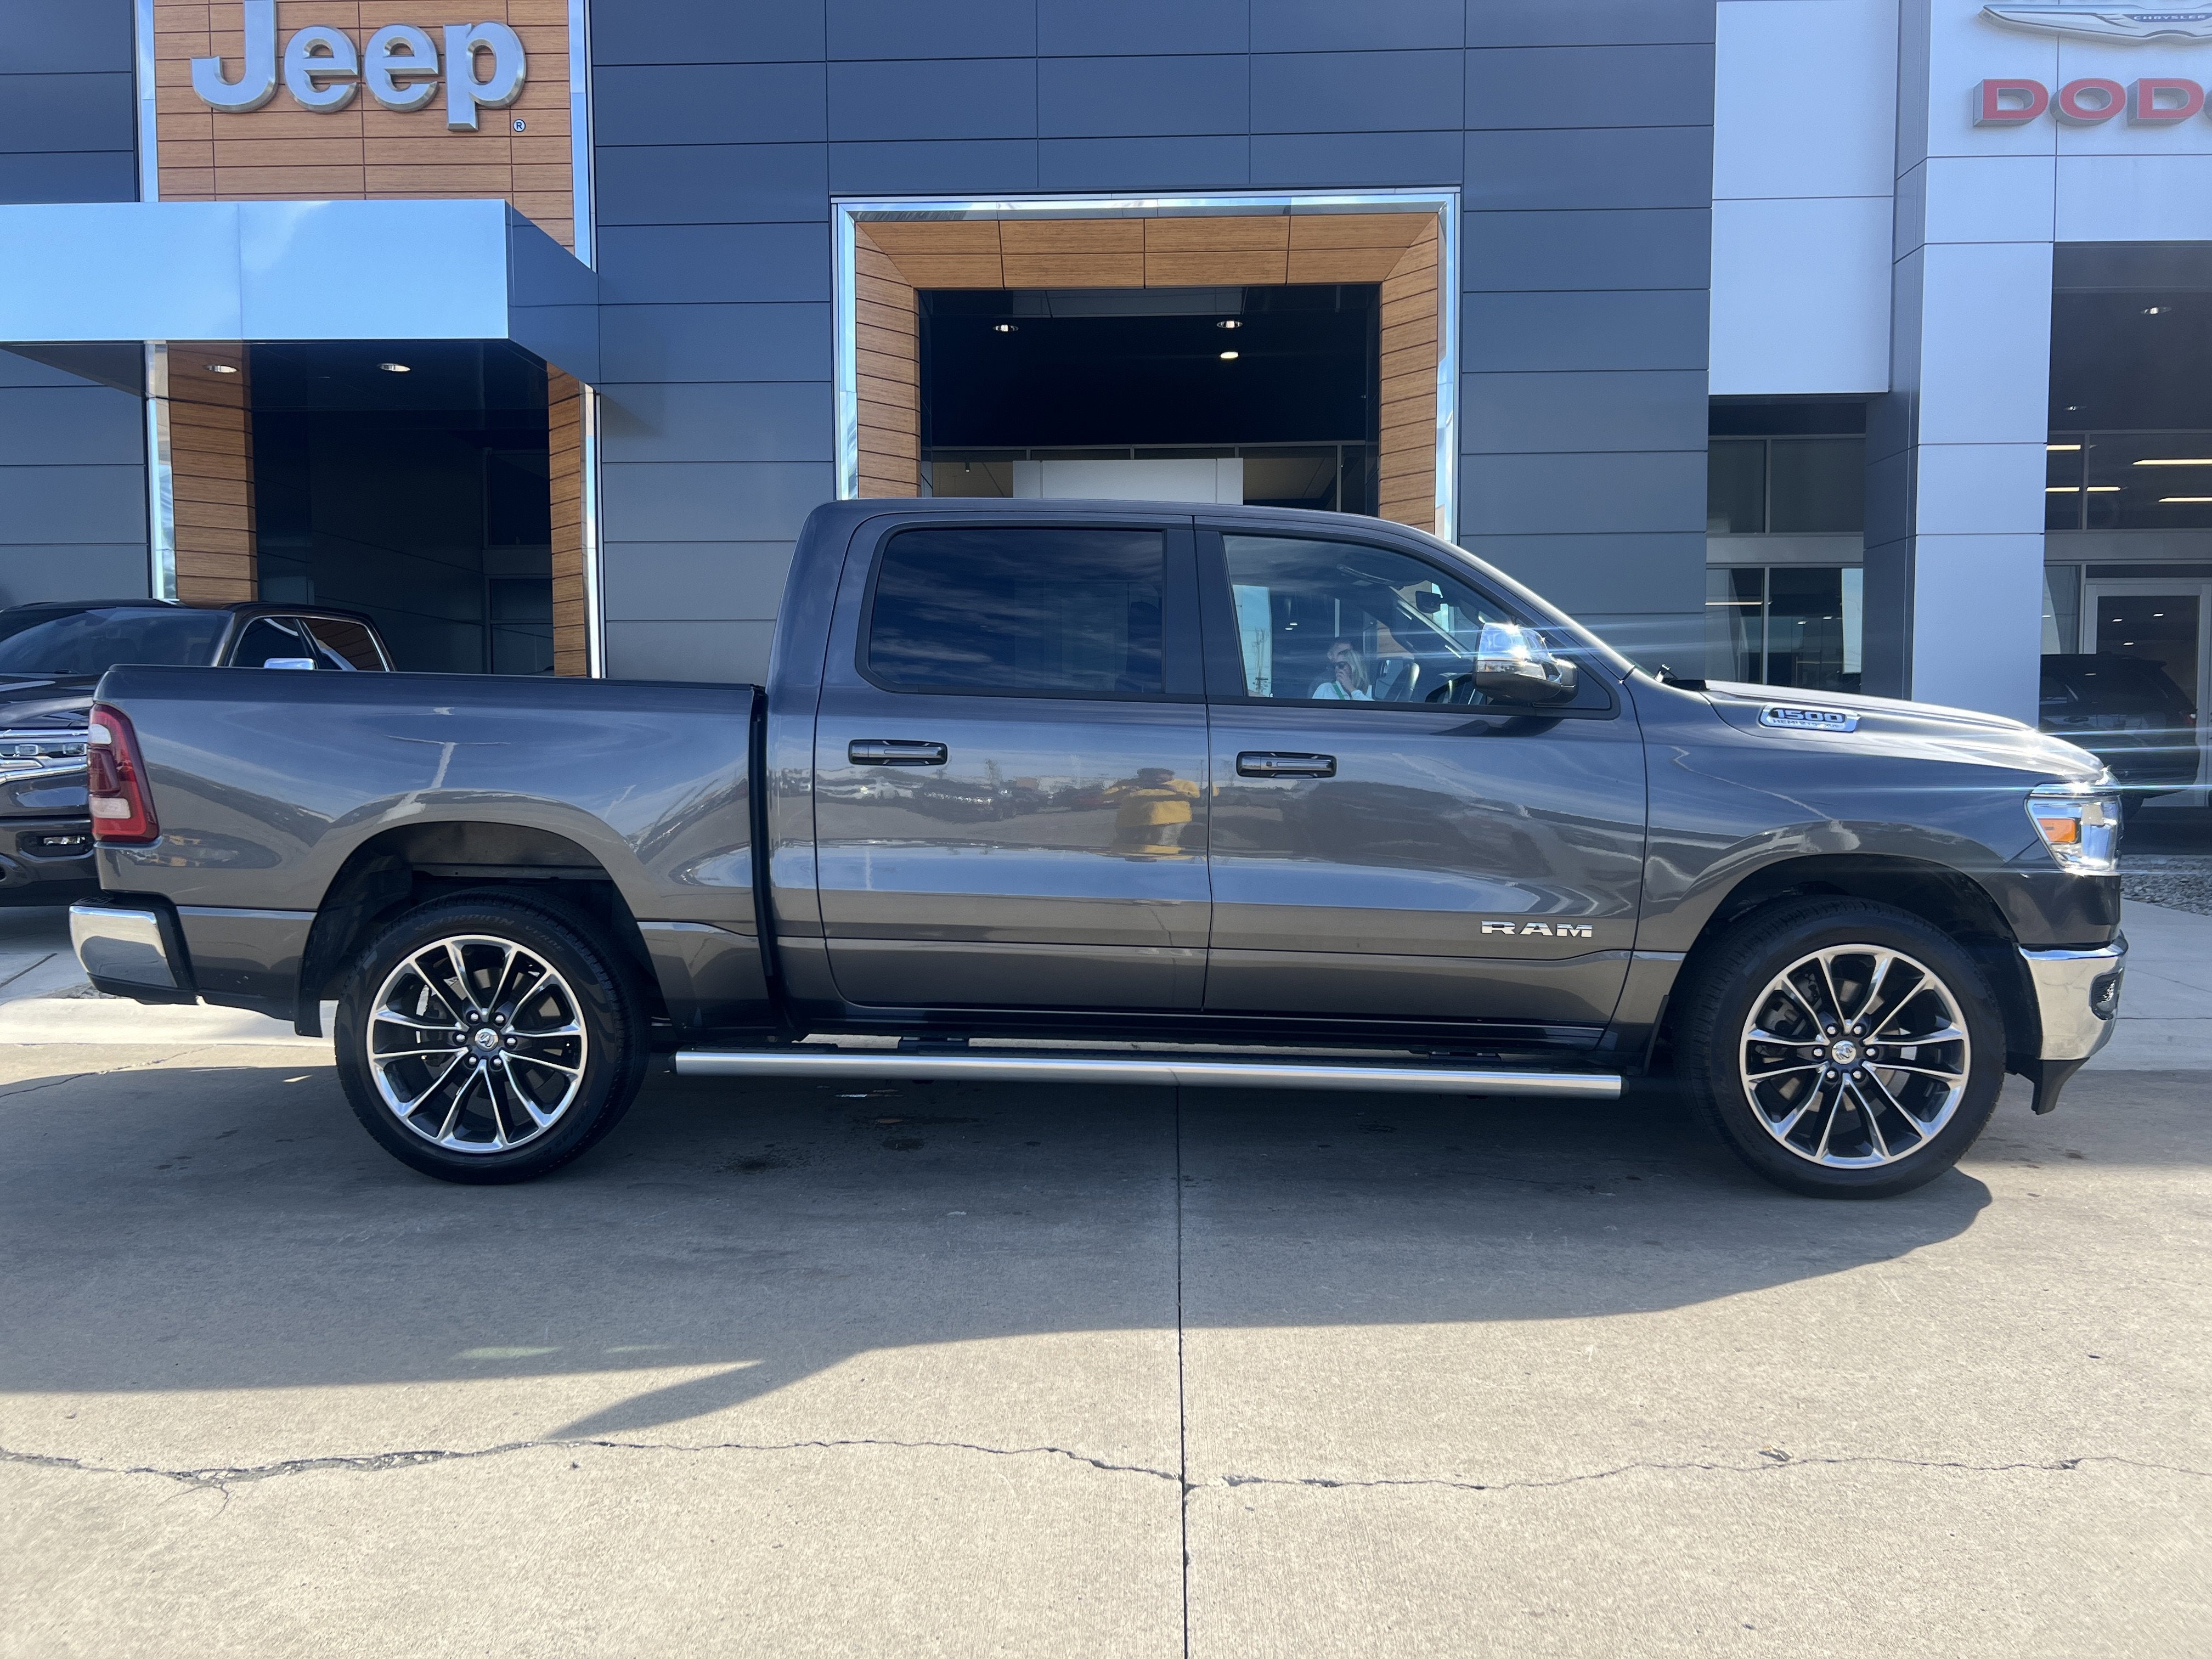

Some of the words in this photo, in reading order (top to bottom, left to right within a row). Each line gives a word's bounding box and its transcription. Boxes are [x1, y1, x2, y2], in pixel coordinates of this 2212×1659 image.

[190, 0, 528, 132] Jeep
[1973, 77, 2212, 127] DOD
[1773, 708, 1844, 723] 1500
[1482, 921, 1593, 938] RAM
